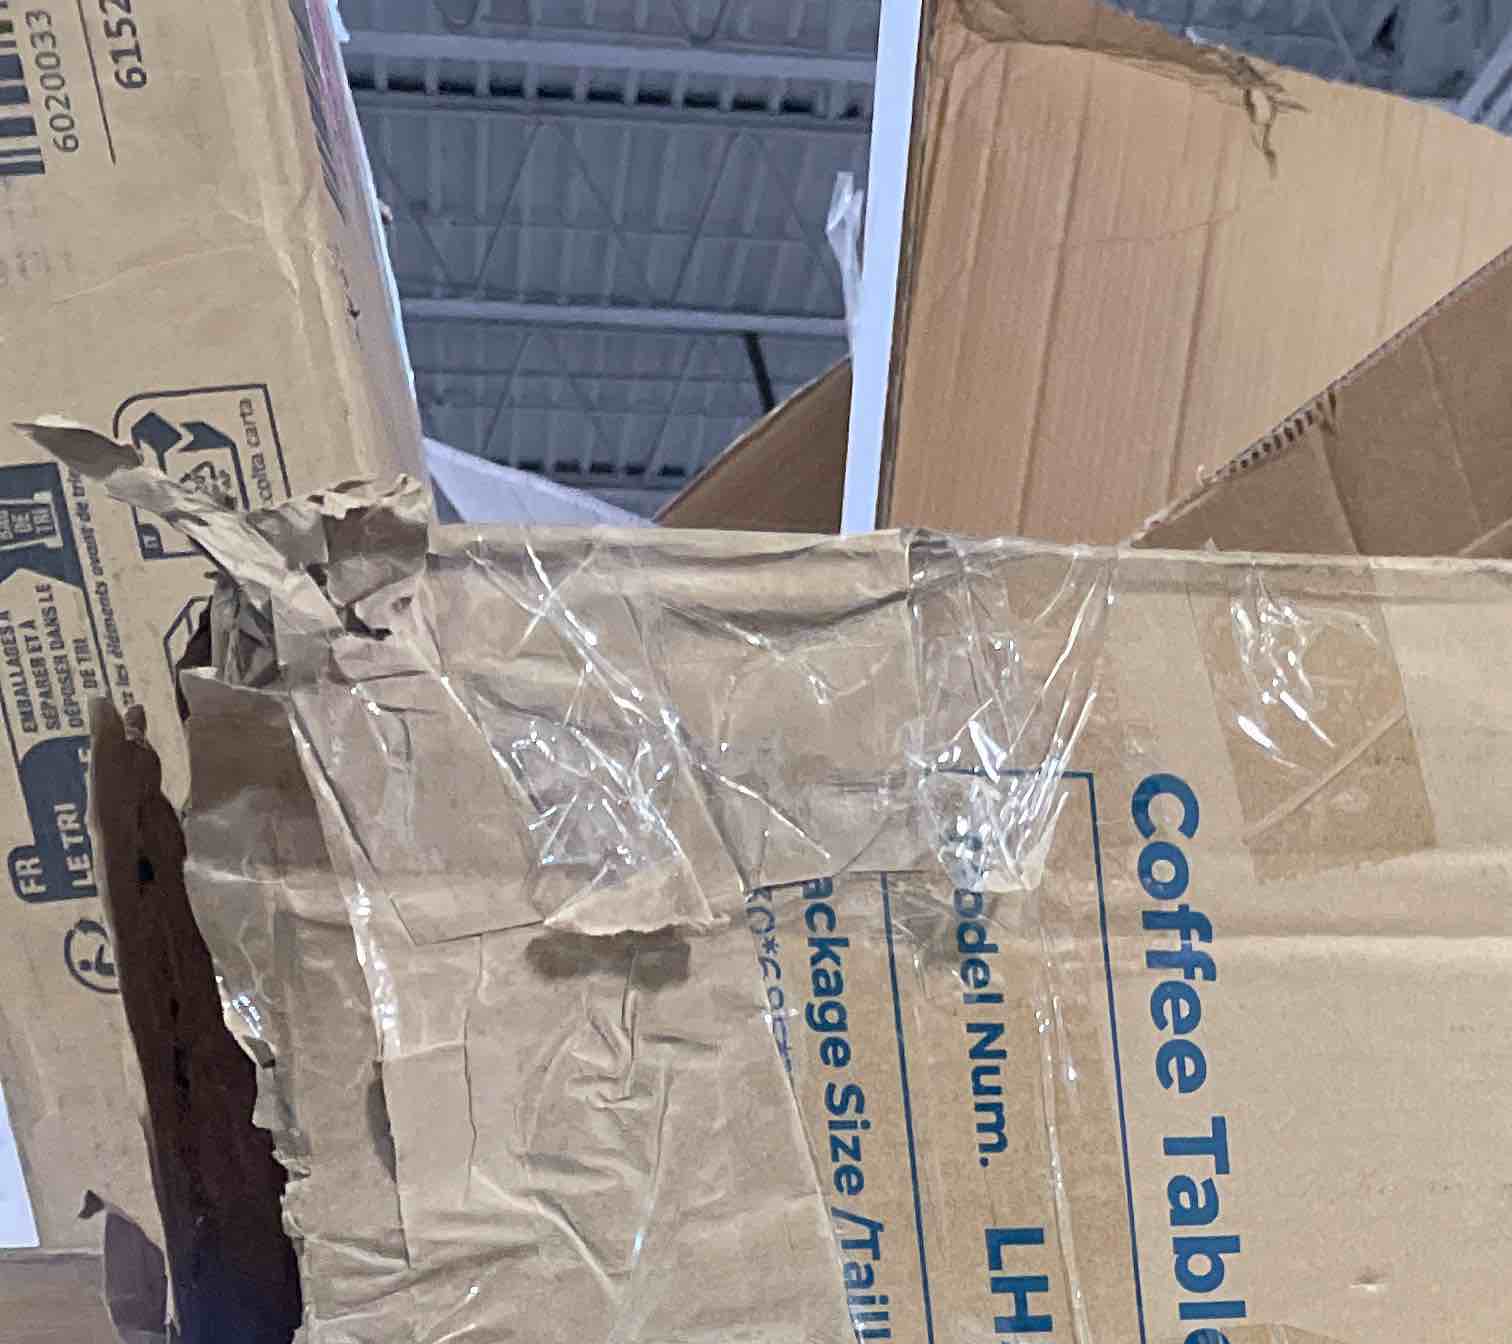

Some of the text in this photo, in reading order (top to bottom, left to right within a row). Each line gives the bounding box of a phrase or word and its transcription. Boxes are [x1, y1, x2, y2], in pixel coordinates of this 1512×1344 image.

[25, 8, 80, 153] 6020033
[238, 398, 262, 449] carta
[35, 583, 53, 603] LE
[23, 634, 43, 655] ET
[41, 605, 65, 651] DANS
[72, 637, 98, 689] DE TRI
[53, 801, 85, 850] TRI
[14, 855, 48, 896] FR
[64, 852, 94, 889] LE
[950, 835, 1005, 1006] odel
[1130, 772, 1217, 1095] Coffee
[800, 876, 852, 1069] ackage
[965, 1022, 1009, 1169] Num.
[823, 1081, 871, 1197] Size
